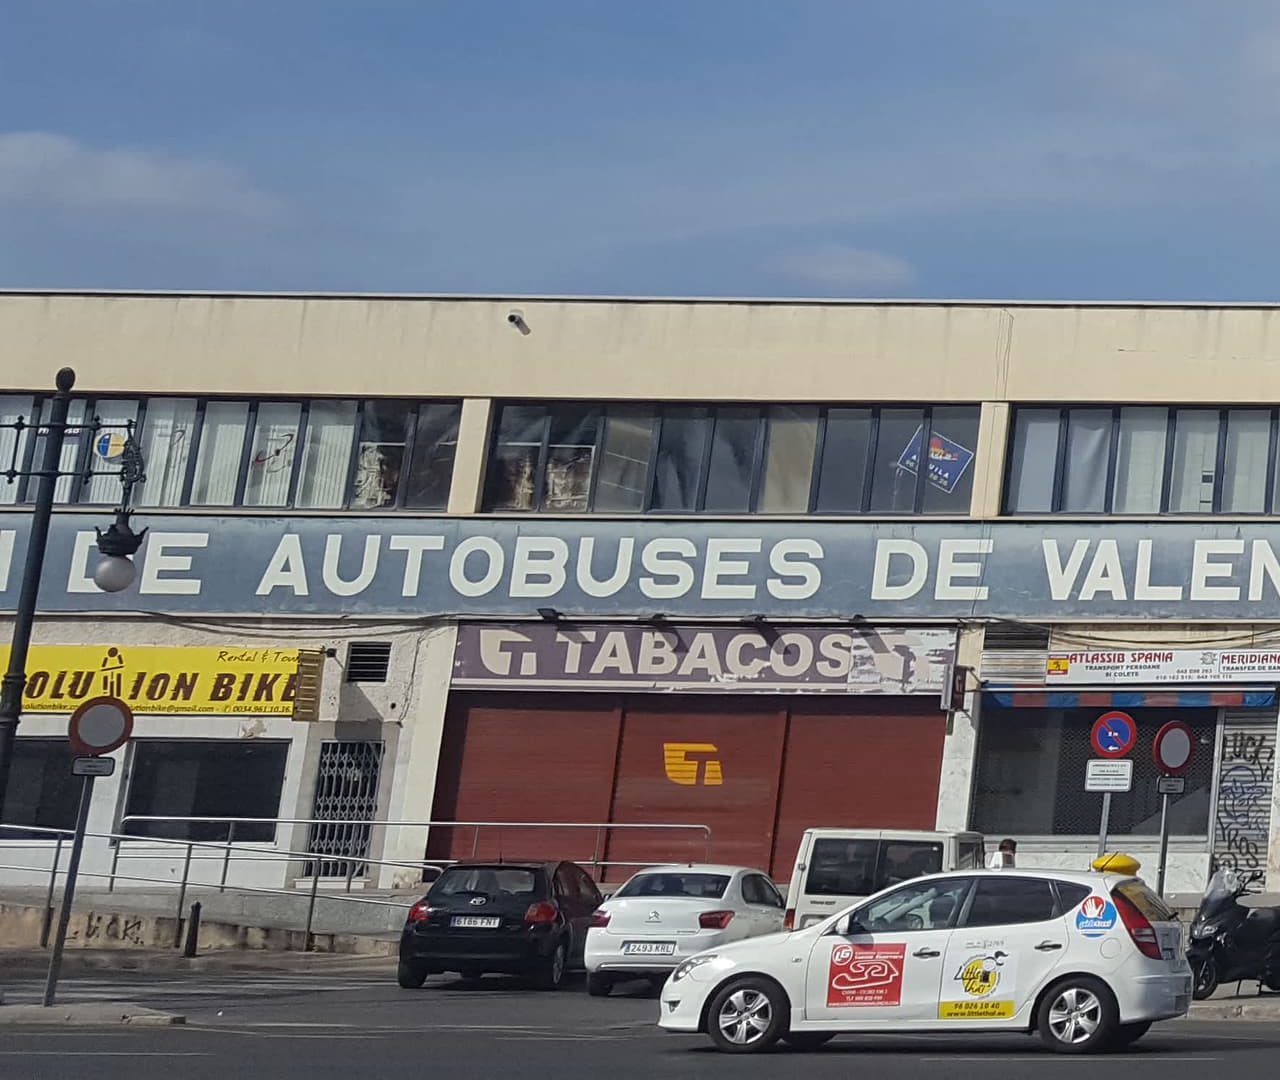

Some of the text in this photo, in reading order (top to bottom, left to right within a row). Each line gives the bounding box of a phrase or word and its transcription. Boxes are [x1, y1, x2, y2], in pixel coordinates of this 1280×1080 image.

[255, 533, 822, 602] AUTOBUSES
[872, 538, 994, 602] DE
[216, 650, 258, 662] Rental
[555, 632, 855, 678] TABACOS
[1068, 652, 1174, 664] ATLASSIB SPANIA
